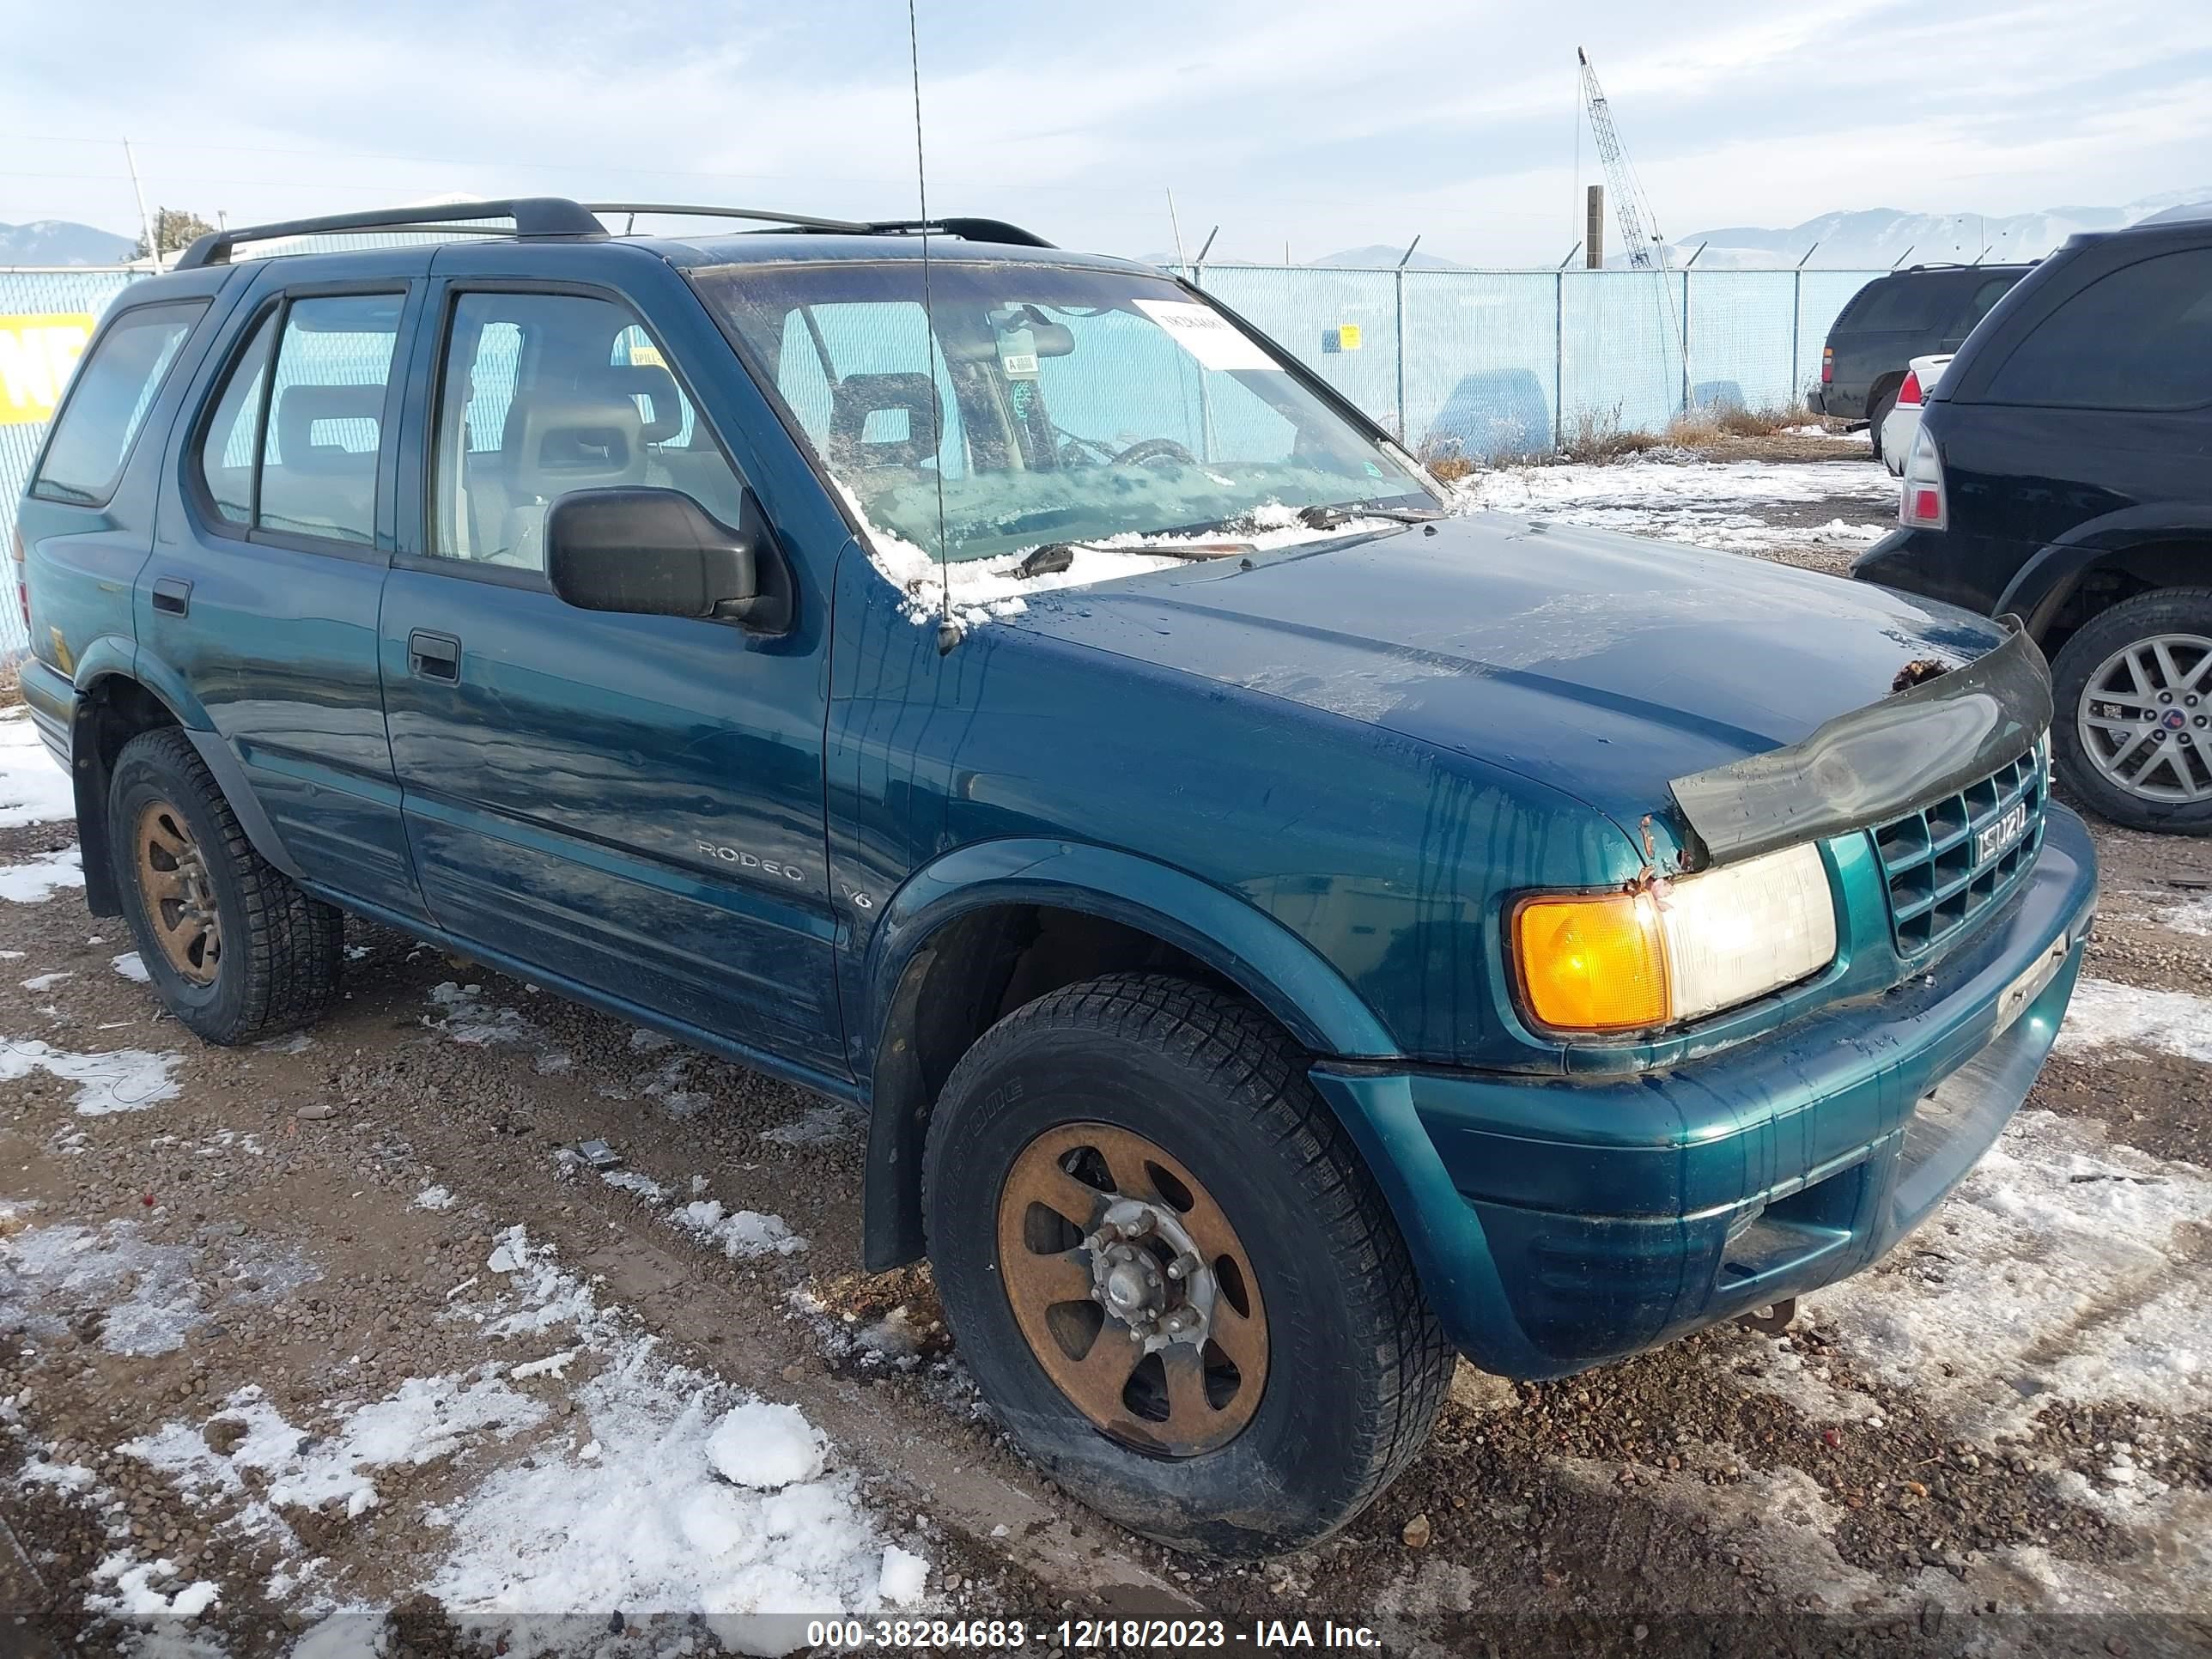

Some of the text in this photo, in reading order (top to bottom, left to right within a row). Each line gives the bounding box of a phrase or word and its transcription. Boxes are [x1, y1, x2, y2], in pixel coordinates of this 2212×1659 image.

[1978, 803, 2026, 862] ISUZU
[696, 839, 805, 881] RODEO
[840, 884, 872, 909] V6
